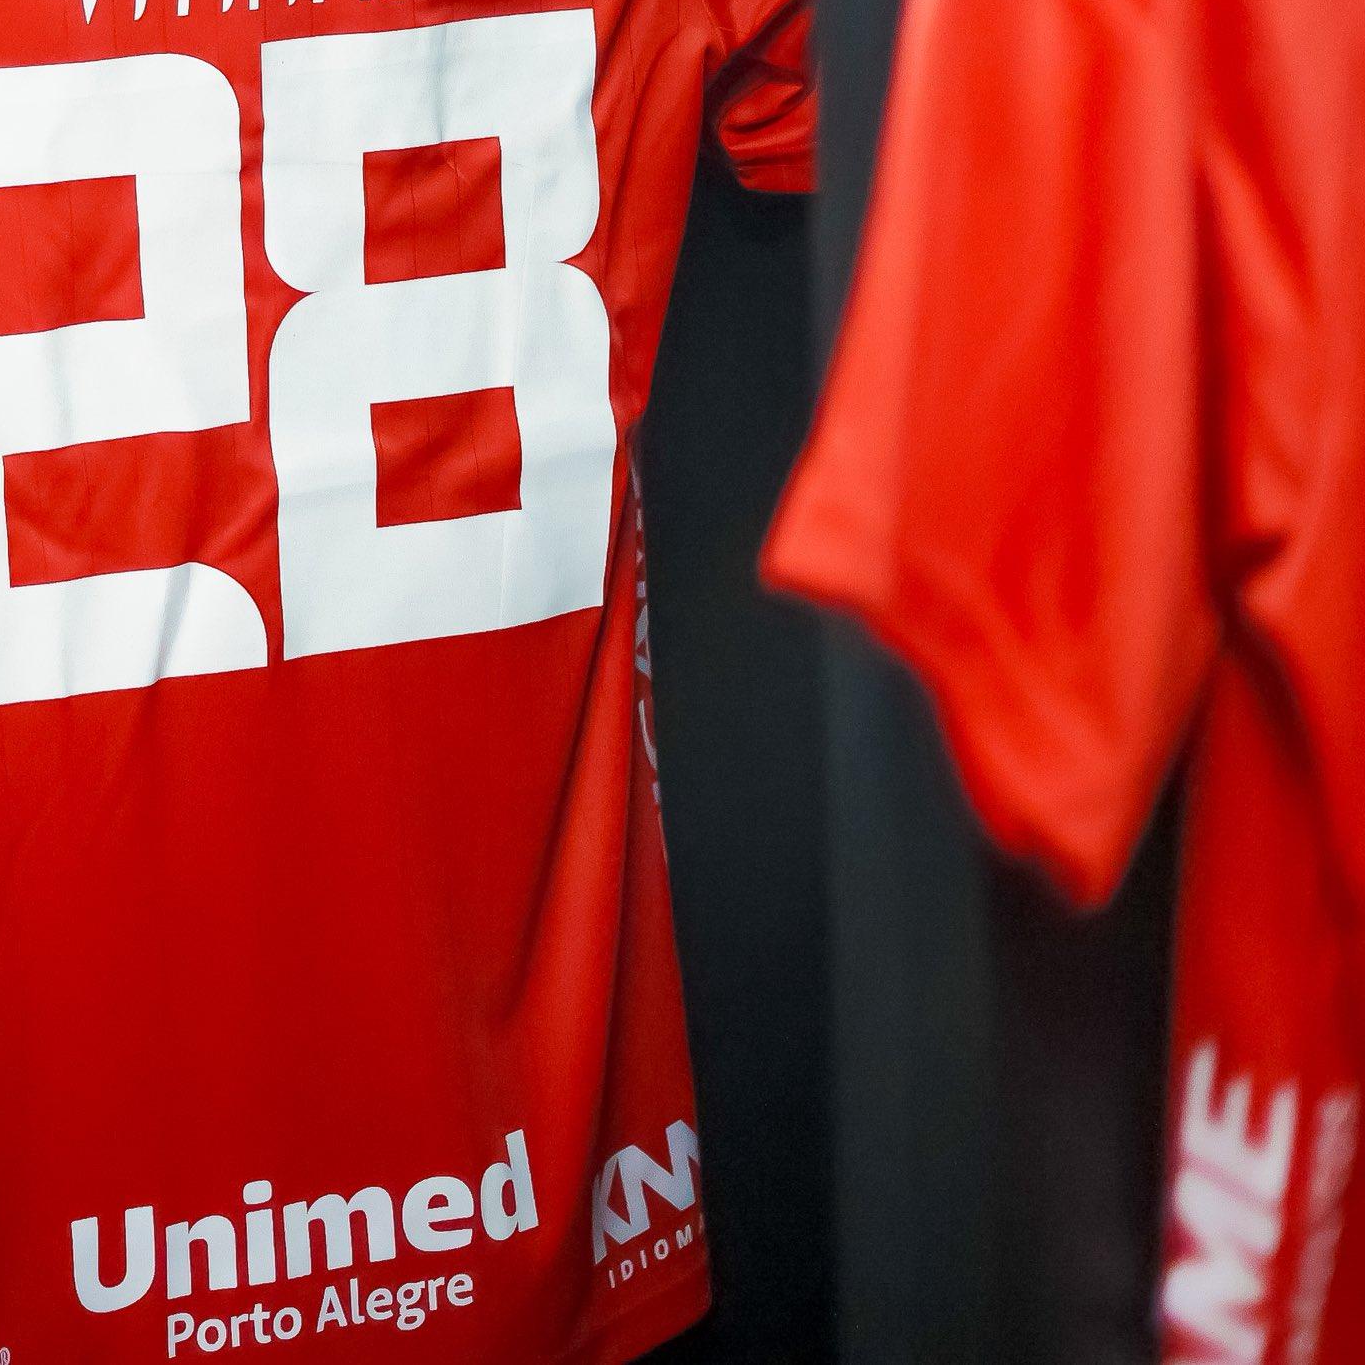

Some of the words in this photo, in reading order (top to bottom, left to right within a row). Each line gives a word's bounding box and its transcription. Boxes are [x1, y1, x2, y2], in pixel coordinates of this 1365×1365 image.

[71, 1128, 539, 1314] Unimed
[607, 1219, 703, 1289] IDIOM
[167, 1304, 303, 1359] Porto
[316, 1273, 474, 1331] Alegre
